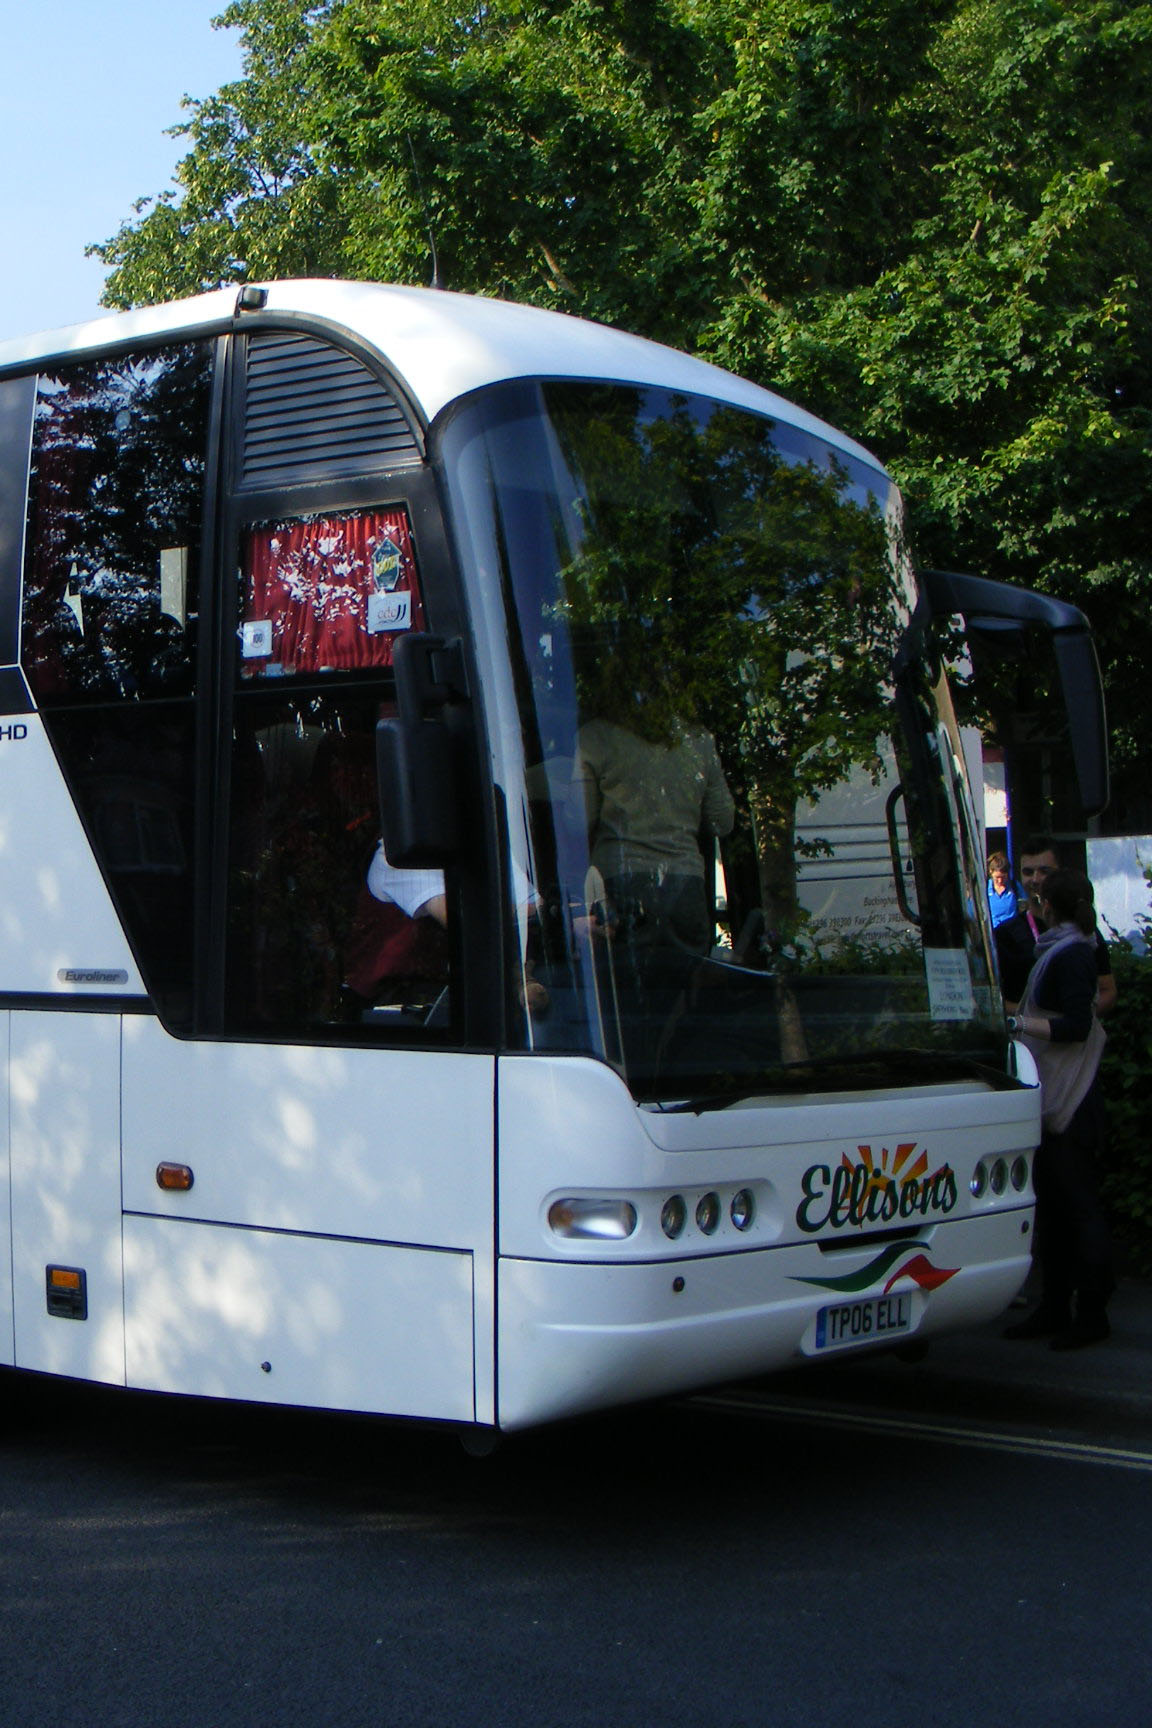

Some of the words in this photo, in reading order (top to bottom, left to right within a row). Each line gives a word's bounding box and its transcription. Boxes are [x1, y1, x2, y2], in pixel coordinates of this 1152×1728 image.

[64, 970, 121, 983] Euroliner
[829, 1303, 873, 1339] TP06
[876, 1298, 908, 1331] ELL
